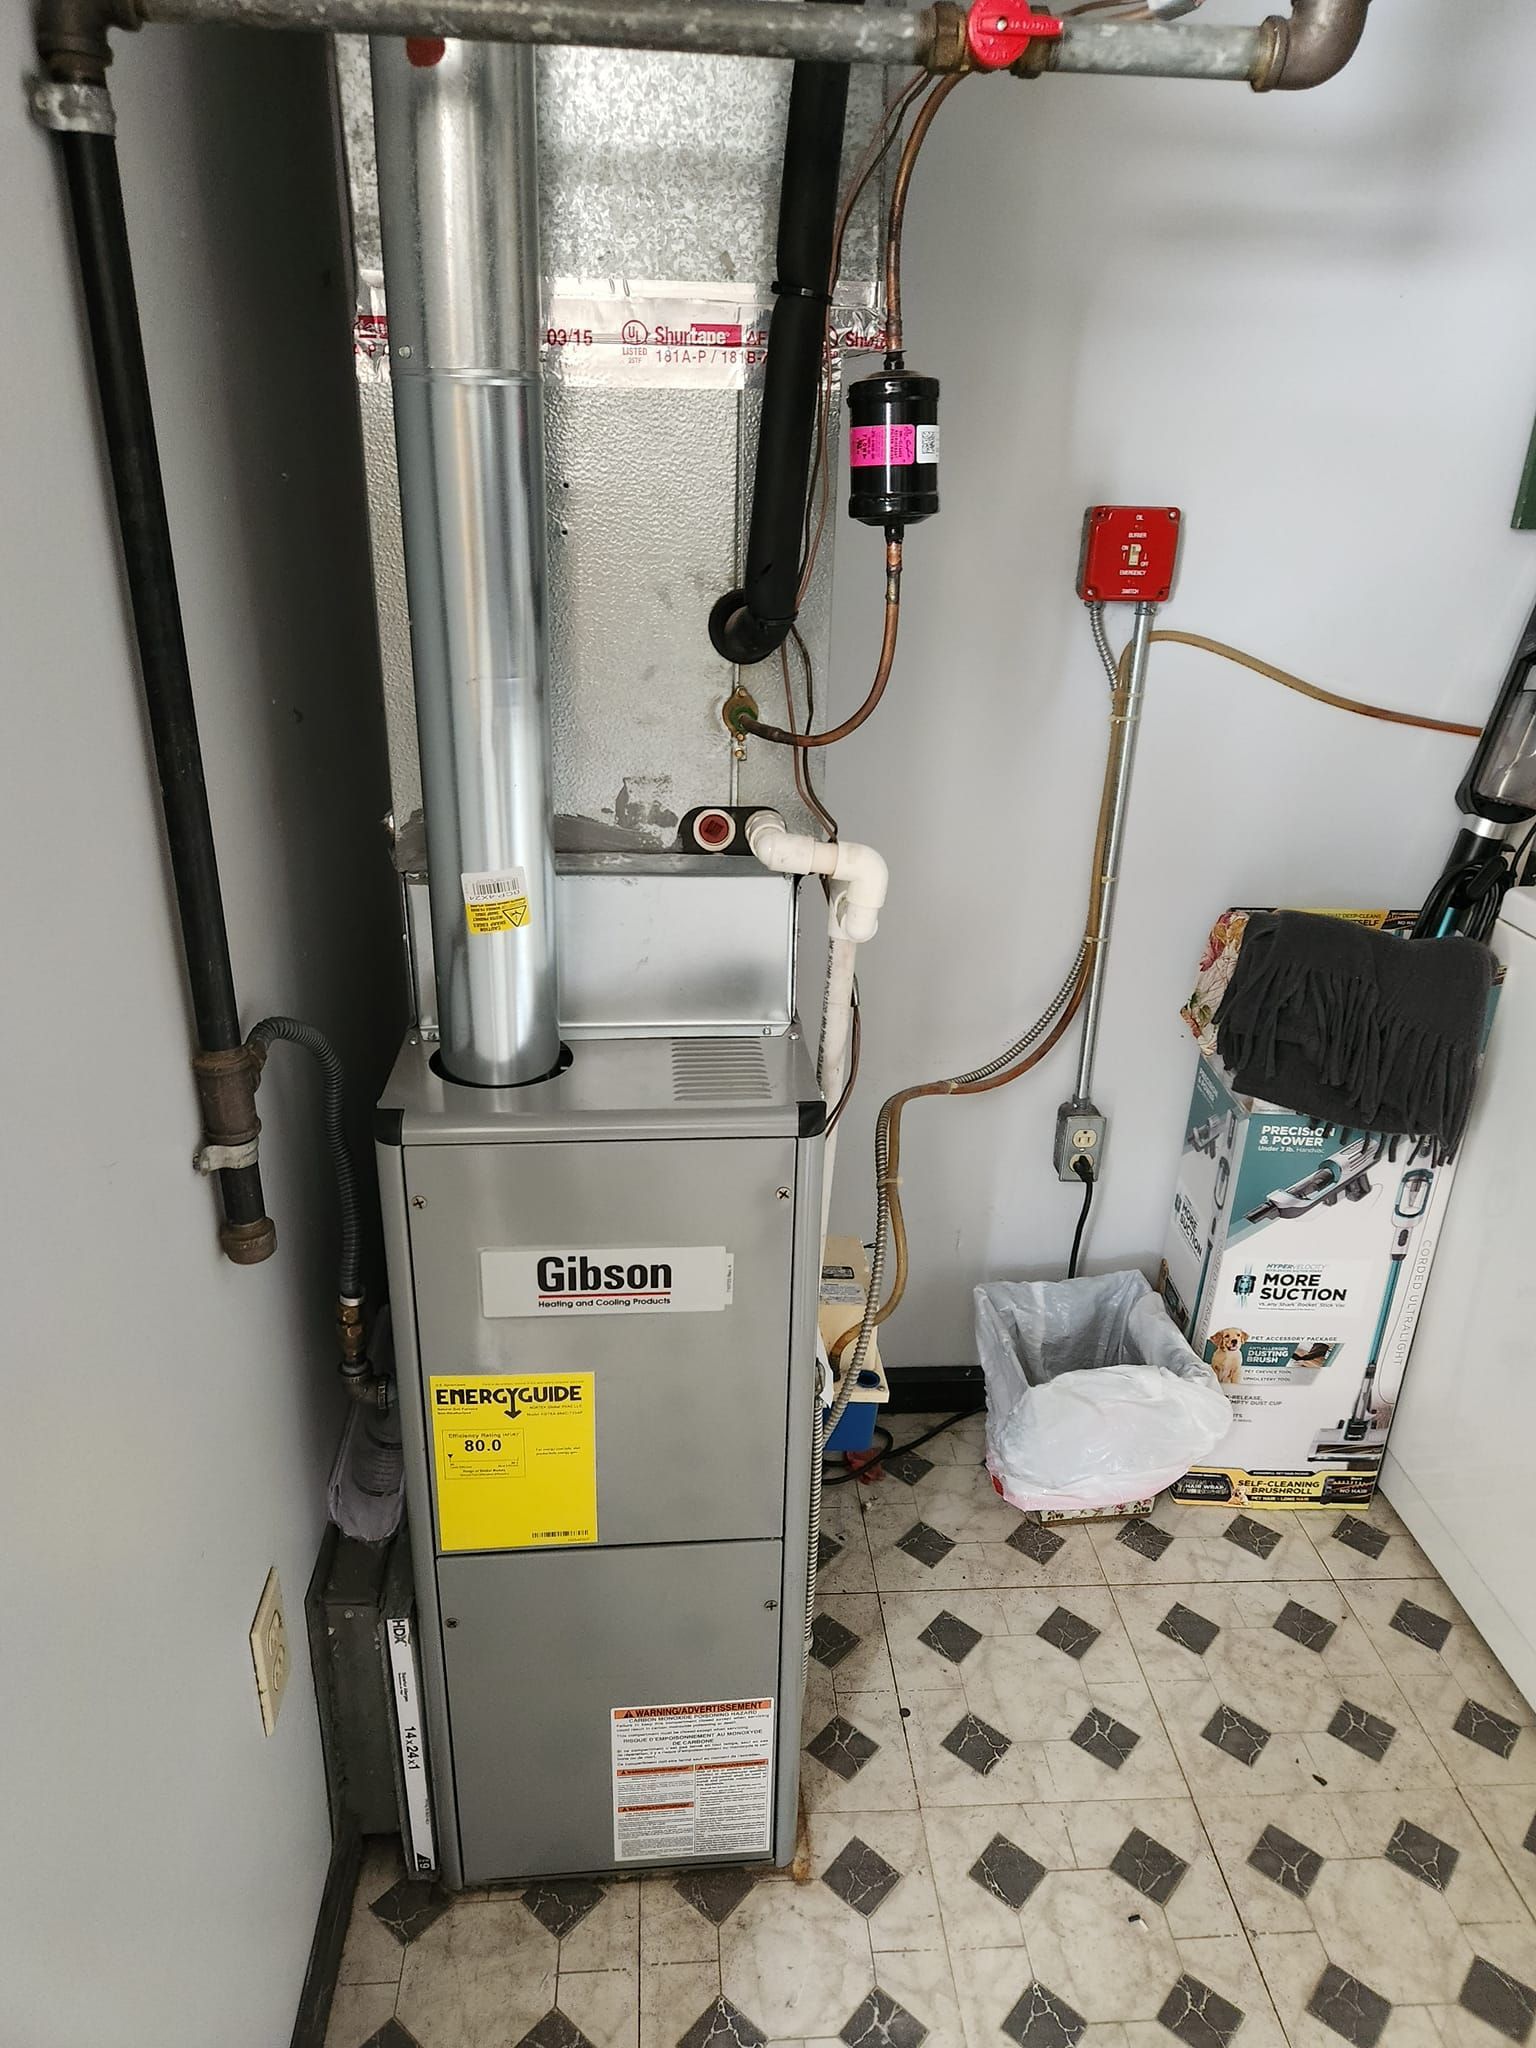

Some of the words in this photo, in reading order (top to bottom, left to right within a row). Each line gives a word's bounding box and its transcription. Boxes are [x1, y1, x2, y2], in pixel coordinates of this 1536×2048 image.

[547, 328, 593, 346] 03/15
[655, 325, 731, 347] Shurtape
[622, 347, 648, 356] LISTED
[656, 351, 706, 364] 181A-P
[1259, 1135, 1269, 1145] &
[1271, 1136, 1324, 1147] POWER
[1412, 1239, 1433, 1291] CORDED
[536, 1256, 673, 1292] Gibson
[1263, 1273, 1322, 1287] MORE
[1259, 1287, 1348, 1301] SUCTION
[538, 1300, 574, 1309] Heating
[575, 1299, 594, 1307] and
[595, 1298, 631, 1307] Cooling
[632, 1297, 671, 1305] Products
[1392, 1293, 1419, 1367] ULTRALIGHT
[1246, 1356, 1279, 1364] BRUSH
[1247, 1350, 1289, 1358] DUSTING
[464, 1439, 502, 1452] 80.0
[1238, 1479, 1320, 1488] SELF-CLEANING
[1251, 1487, 1313, 1495] BRUSHROLL
[392, 1619, 407, 1645] HDX
[635, 1701, 763, 1718] WARNING/ADVERTISSEMENT
[727, 1728, 763, 1736] MONOXYDE
[404, 1726, 421, 1770] 14x24x1
